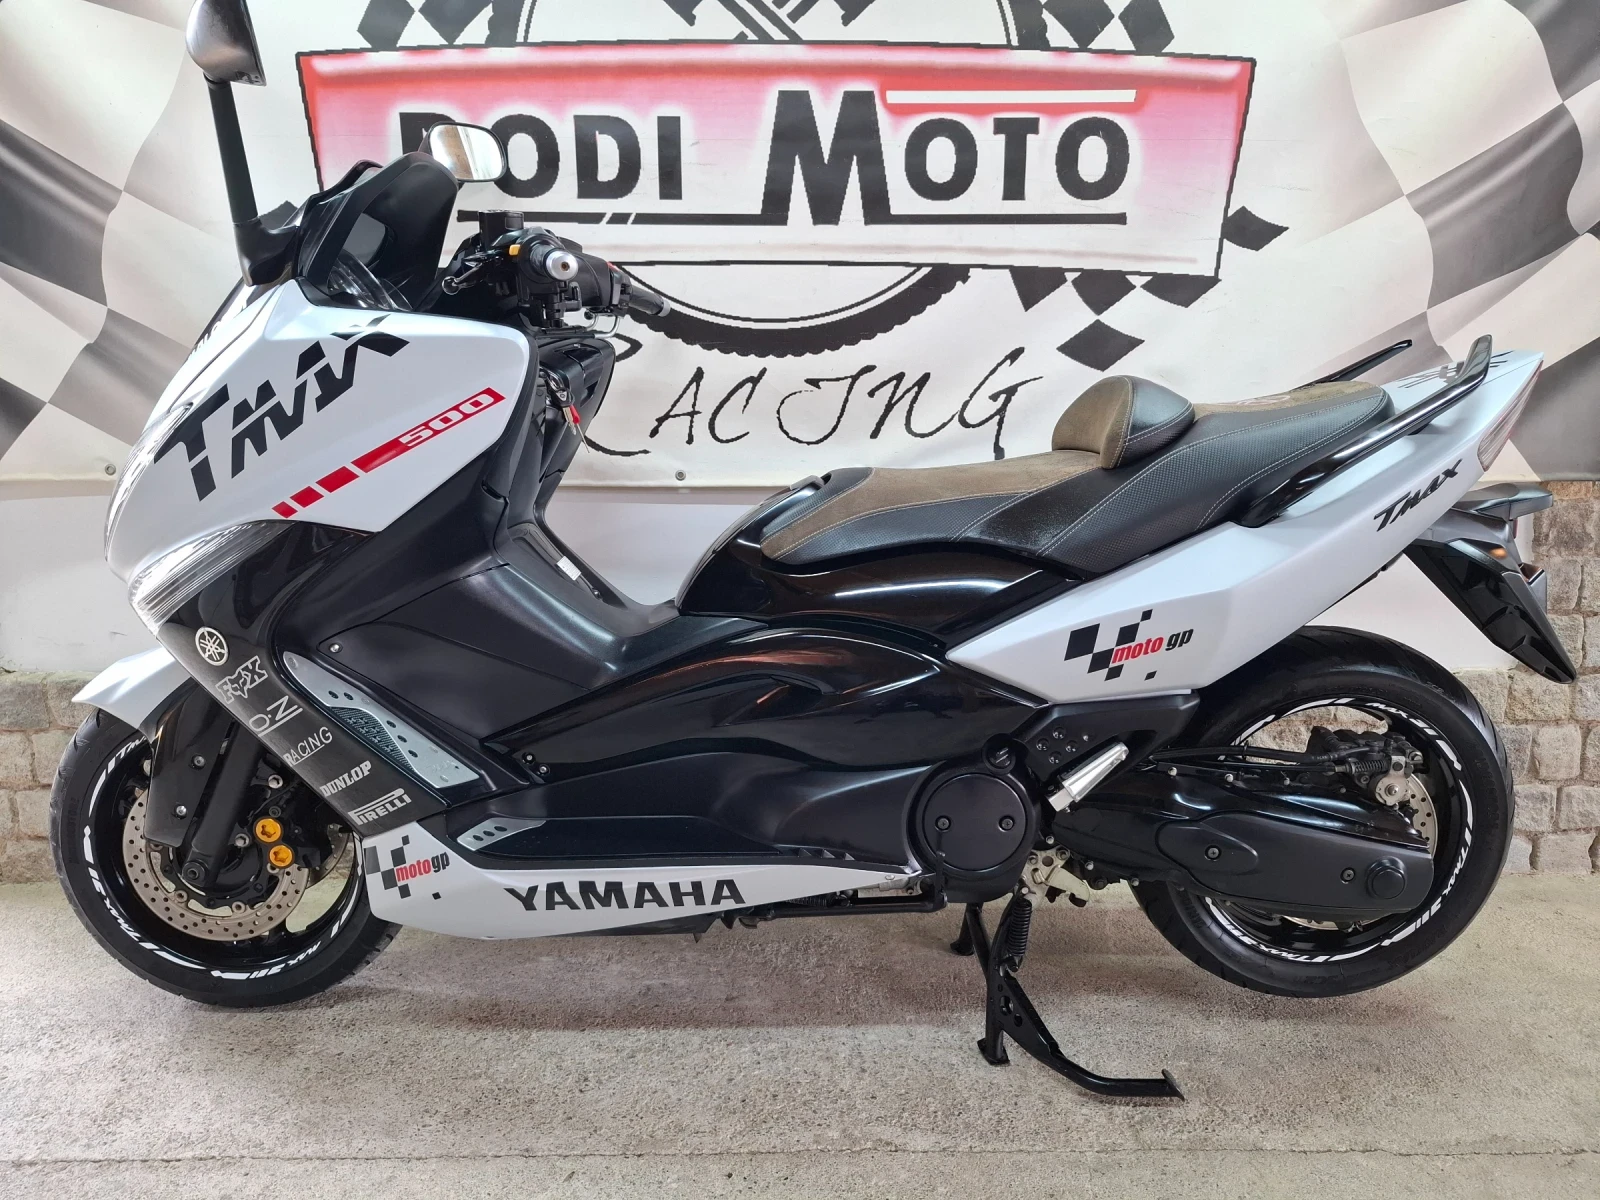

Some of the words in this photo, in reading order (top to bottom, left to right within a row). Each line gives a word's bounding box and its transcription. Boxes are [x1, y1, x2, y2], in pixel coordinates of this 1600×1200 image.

[154, 314, 410, 502] TMAX
[398, 393, 496, 447] 500
[1111, 636, 1164, 664] moto
[1165, 628, 1194, 651] gp
[283, 726, 333, 767] RACING
[319, 760, 372, 798] DUNLOP
[348, 787, 412, 826] PIRELLI
[504, 878, 747, 912] YAMAHA
